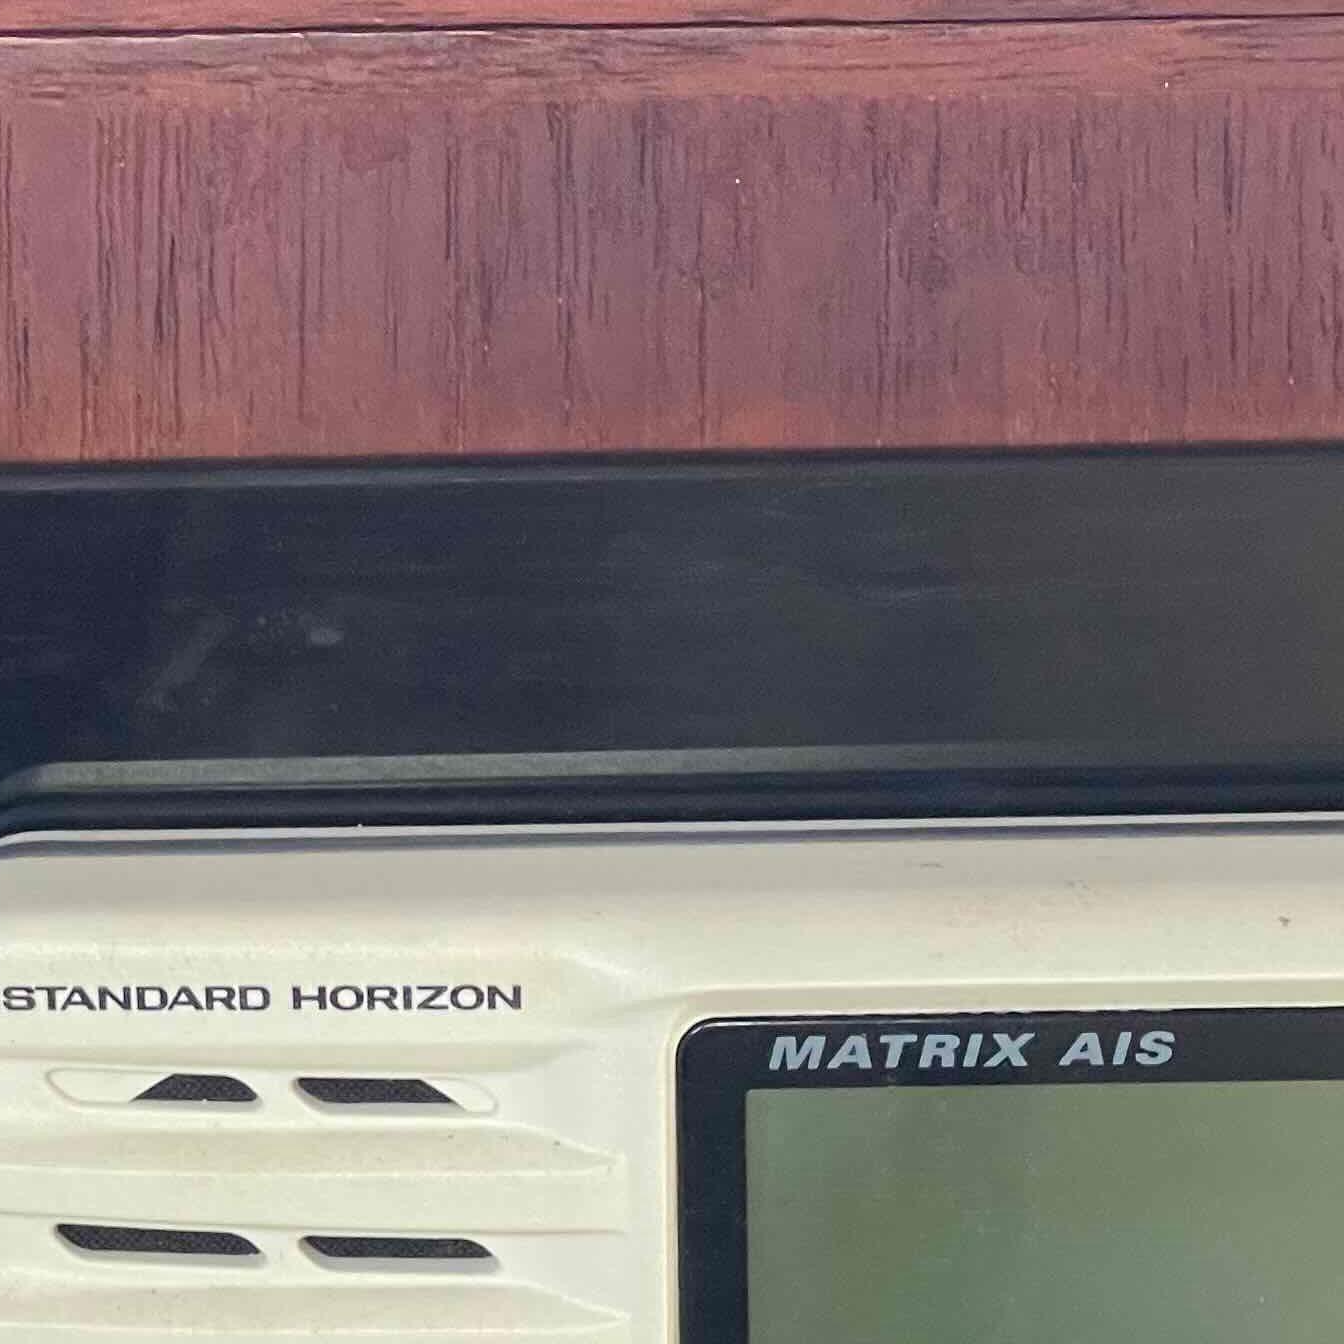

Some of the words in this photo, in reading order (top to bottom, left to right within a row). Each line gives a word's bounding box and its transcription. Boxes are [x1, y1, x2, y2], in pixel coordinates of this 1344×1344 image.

[2, 985, 271, 1011] STANDARD
[291, 984, 522, 1011] HORIZON
[768, 1032, 1036, 1071] MATRIX
[1058, 1030, 1176, 1066] AIS
